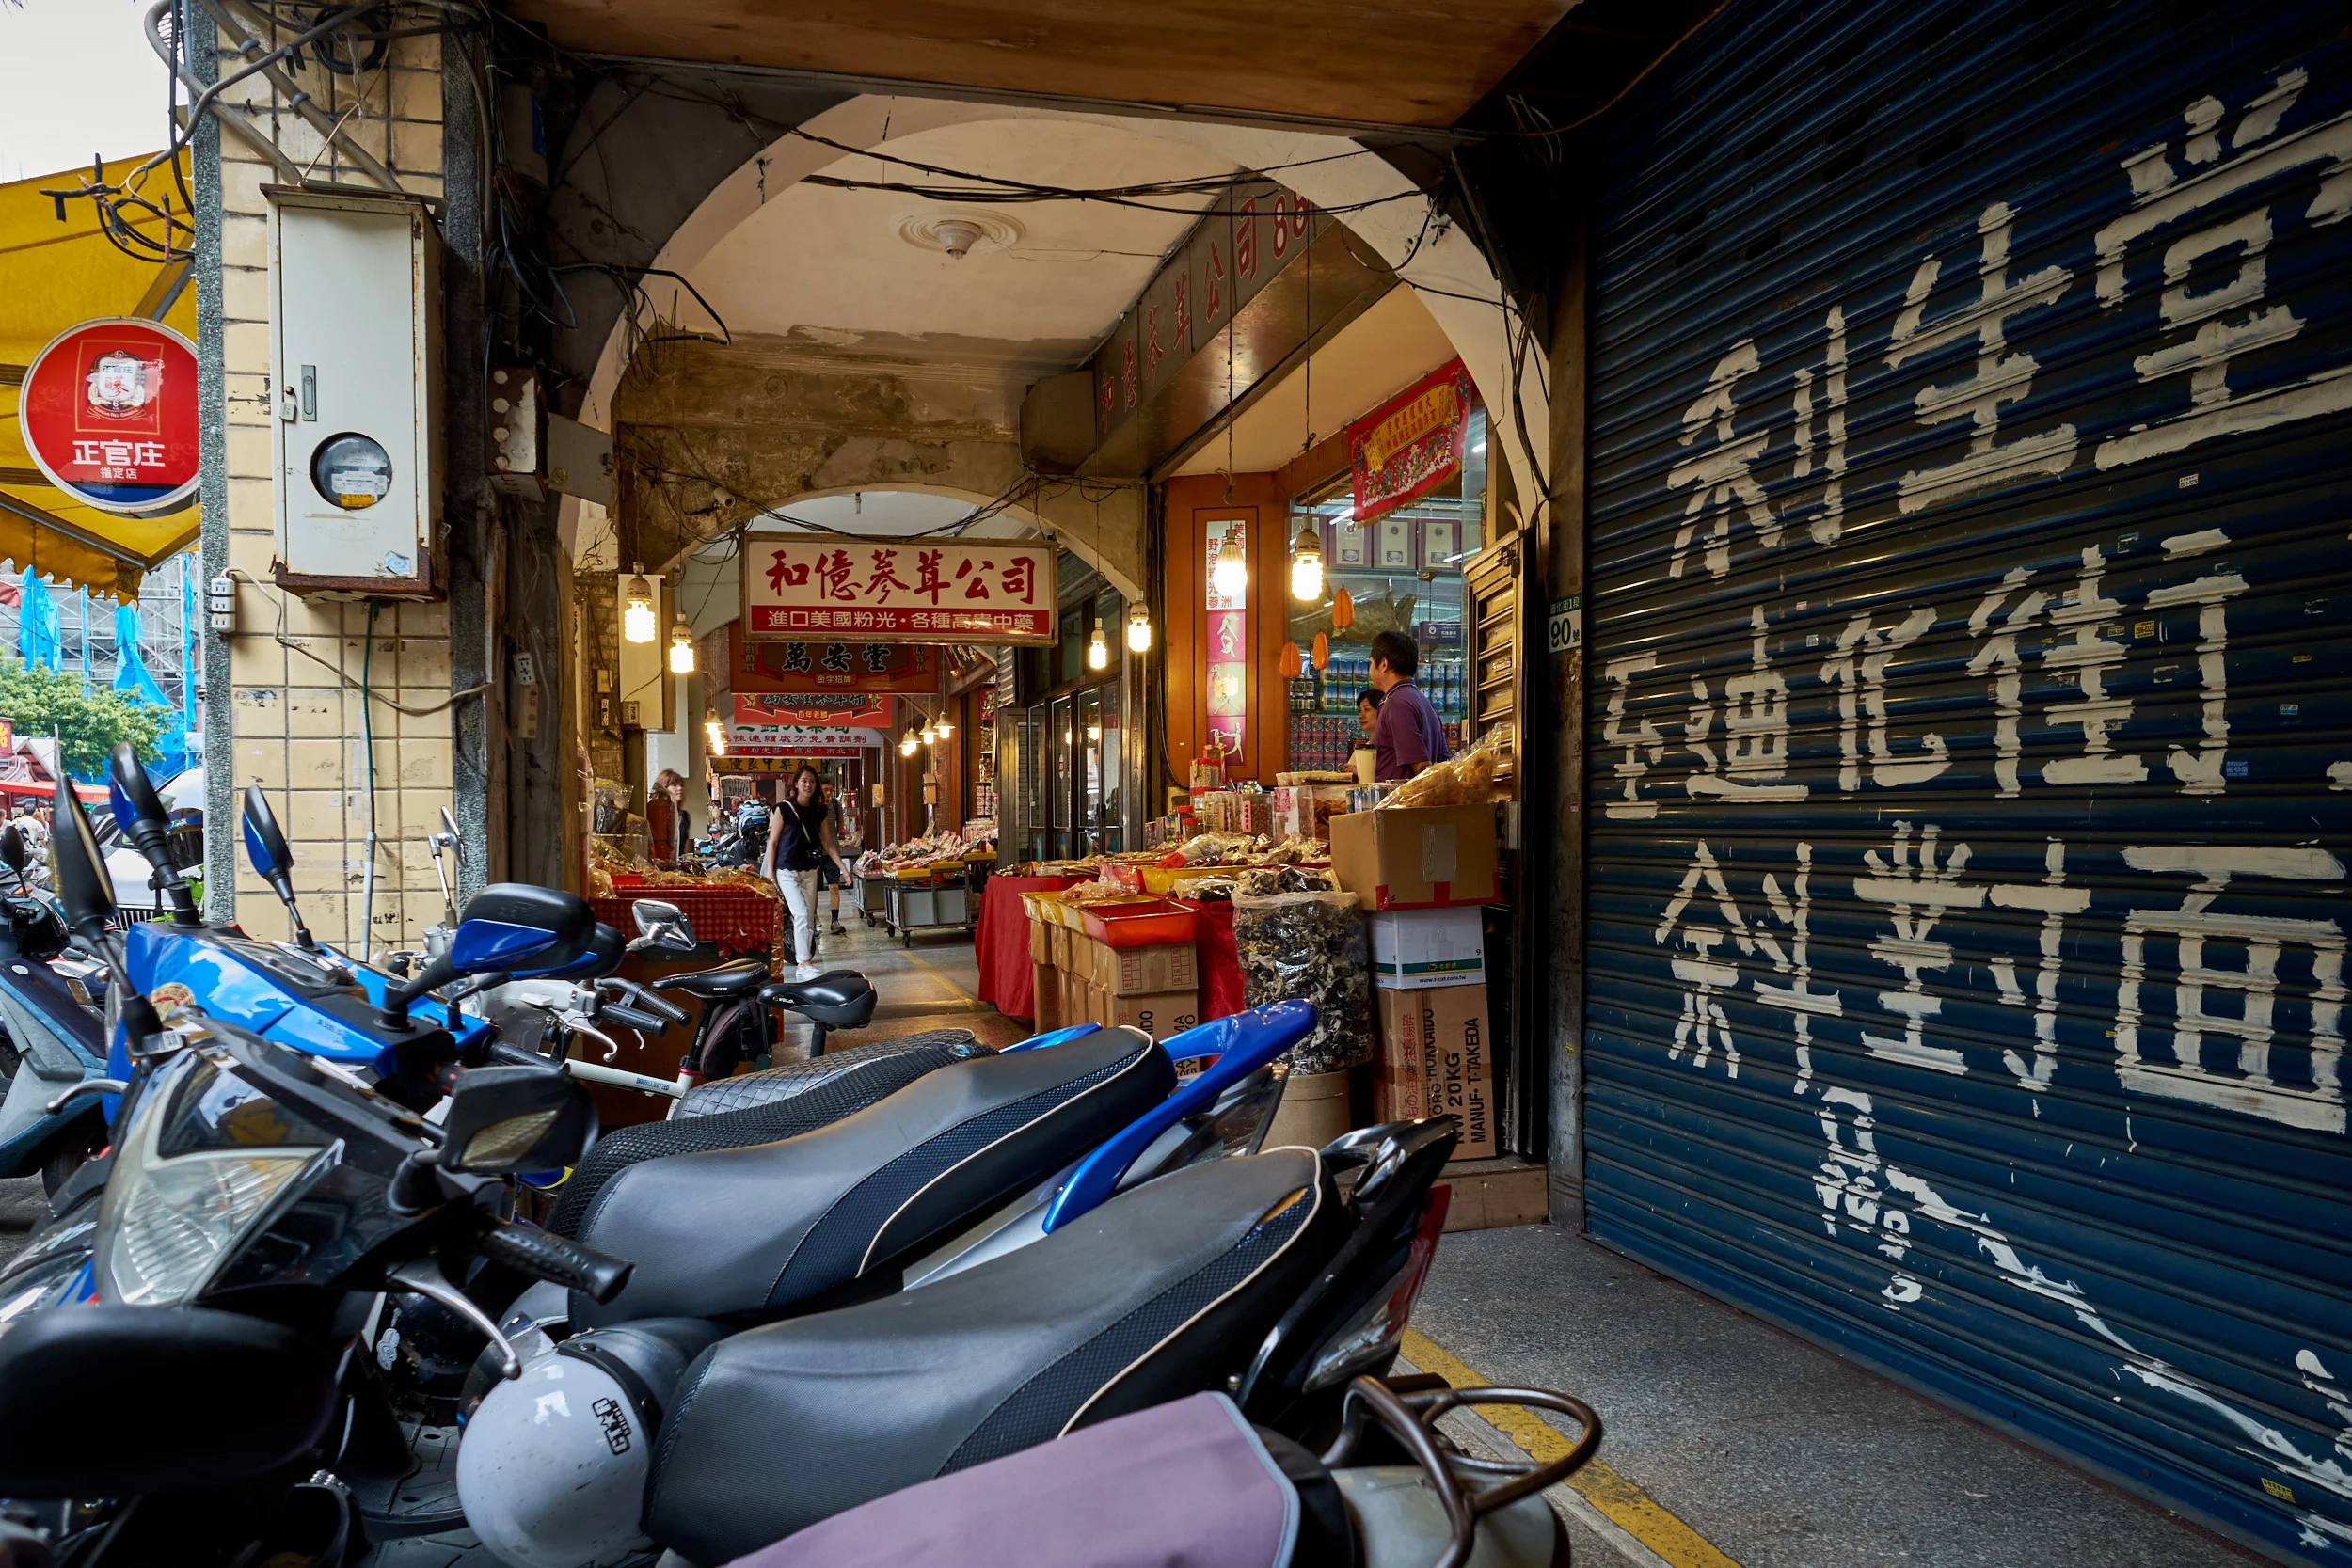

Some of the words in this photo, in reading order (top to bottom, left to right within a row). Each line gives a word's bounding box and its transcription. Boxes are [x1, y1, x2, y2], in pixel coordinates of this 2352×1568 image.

[1666, 66, 2352, 579] 利生堂
[72, 439, 166, 467] 正官庄
[100, 467, 137, 479] 指定店
[1550, 617, 1571, 648] 90
[782, 642, 892, 672] 萬安堂
[1445, 1053, 1463, 1106] 20KG
